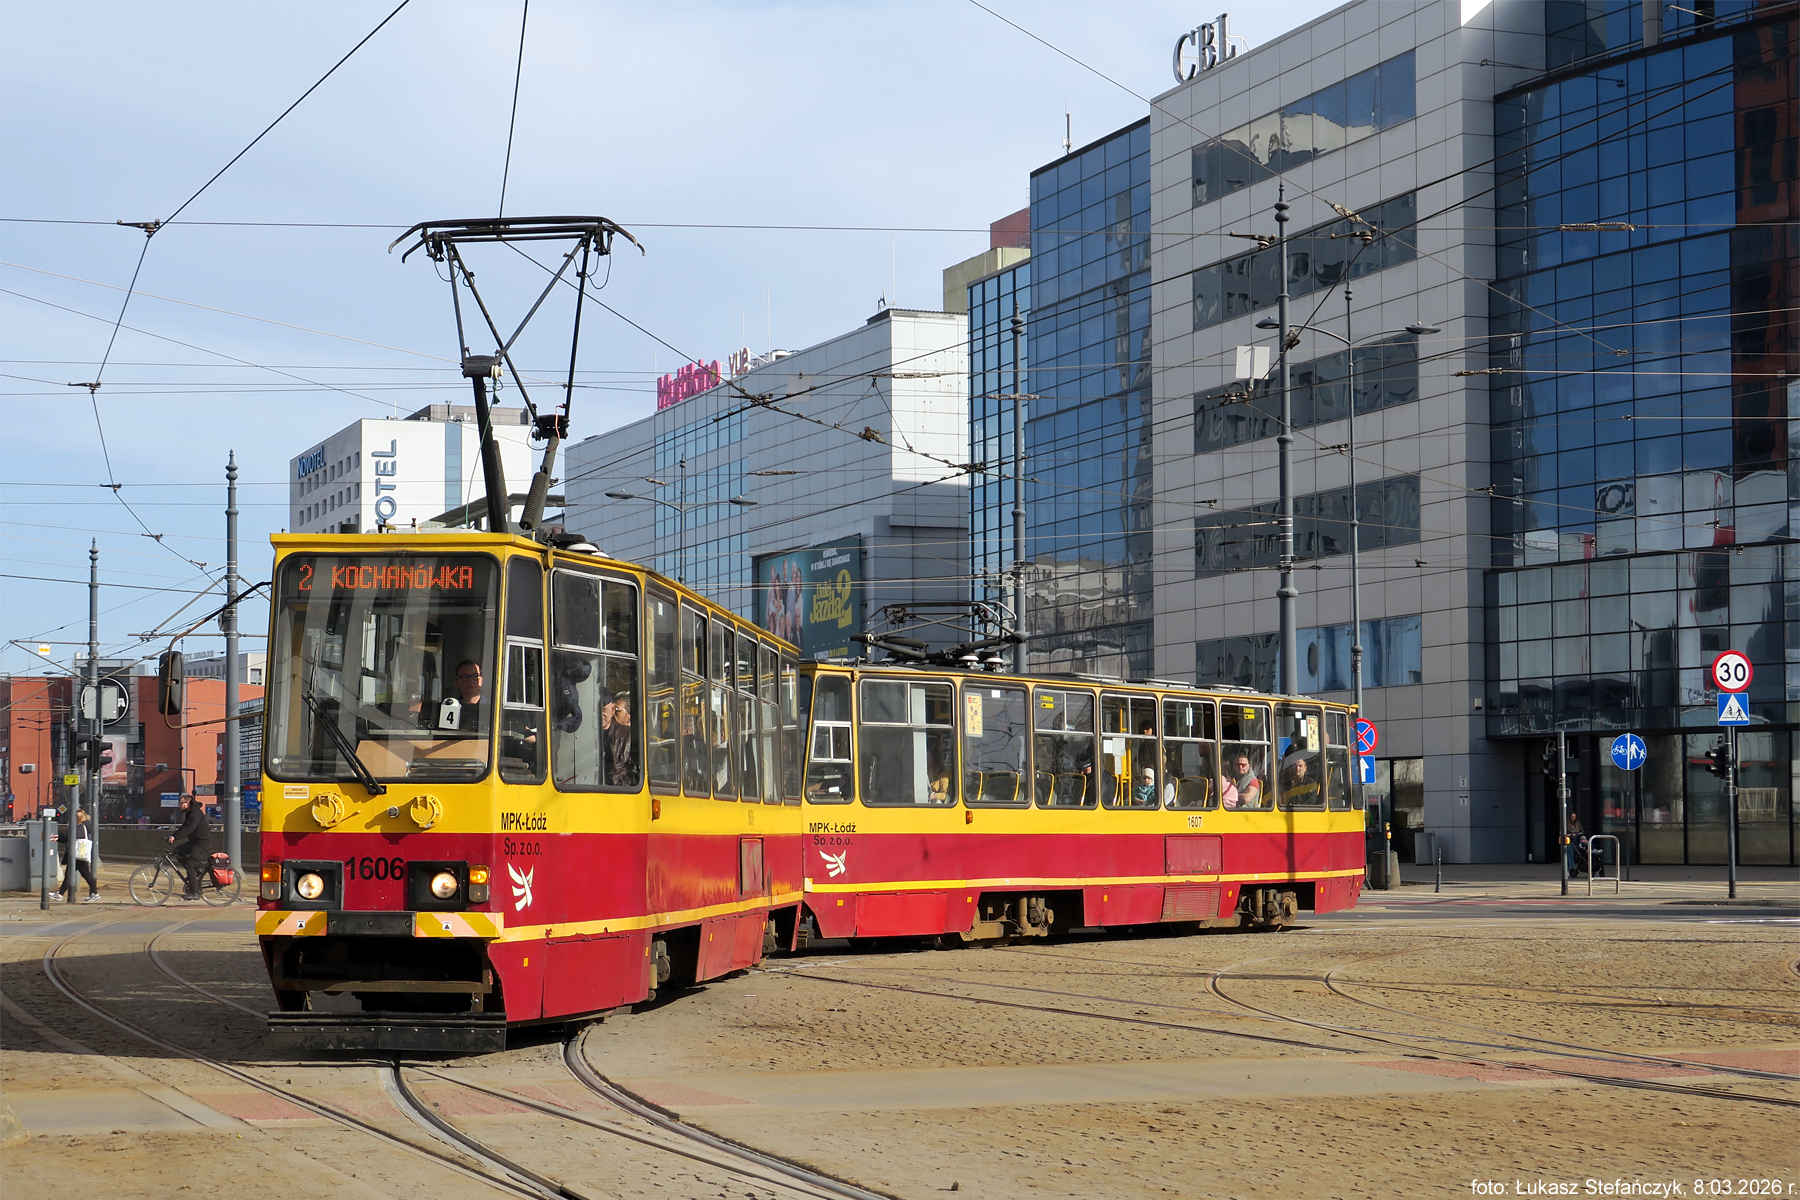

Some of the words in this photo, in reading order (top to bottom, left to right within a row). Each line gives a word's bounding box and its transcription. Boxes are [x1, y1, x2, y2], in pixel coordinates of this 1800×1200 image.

[1173, 13, 1236, 85] CBL
[297, 444, 326, 479] NOVOTEL
[371, 439, 397, 526] OTEL
[298, 564, 313, 591] 2
[331, 564, 473, 589] KOCHANÓWKA
[1719, 662, 1746, 682] 30
[446, 711, 455, 725] 4
[501, 812, 547, 831] MPK-Łódź
[809, 822, 856, 832] MPK-Łódź
[1187, 815, 1202, 828] 1607
[344, 856, 405, 881] 1606
